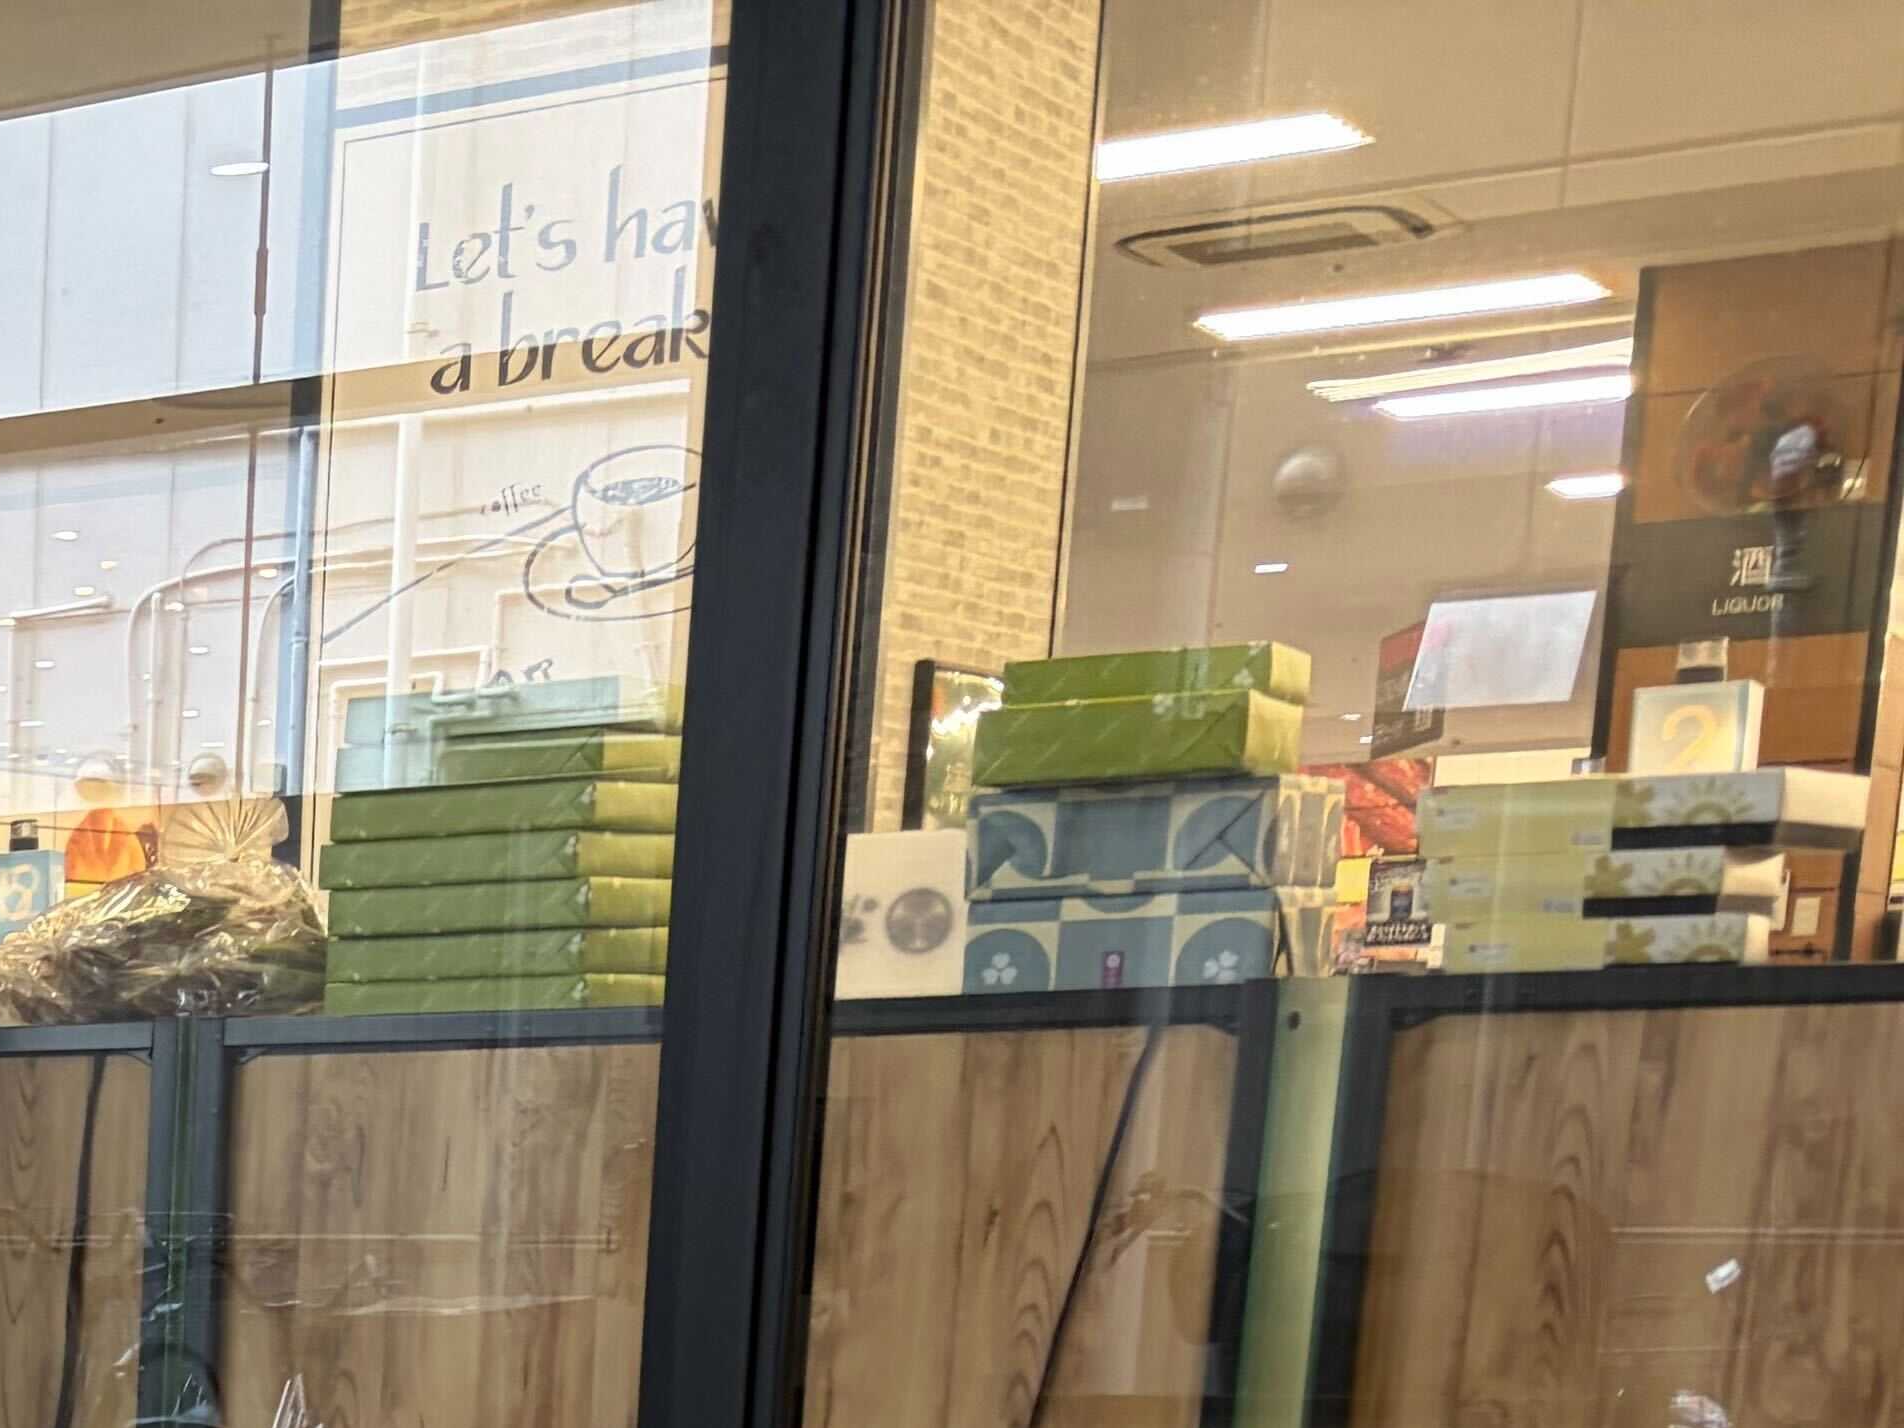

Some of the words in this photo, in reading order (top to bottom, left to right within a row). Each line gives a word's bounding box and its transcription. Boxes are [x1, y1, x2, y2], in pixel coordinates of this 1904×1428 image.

[416, 182, 578, 293] Let's
[430, 338, 472, 396] a
[498, 265, 711, 387] break
[1712, 594, 1784, 616] LIQUOR
[1729, 546, 1775, 588] 酒
